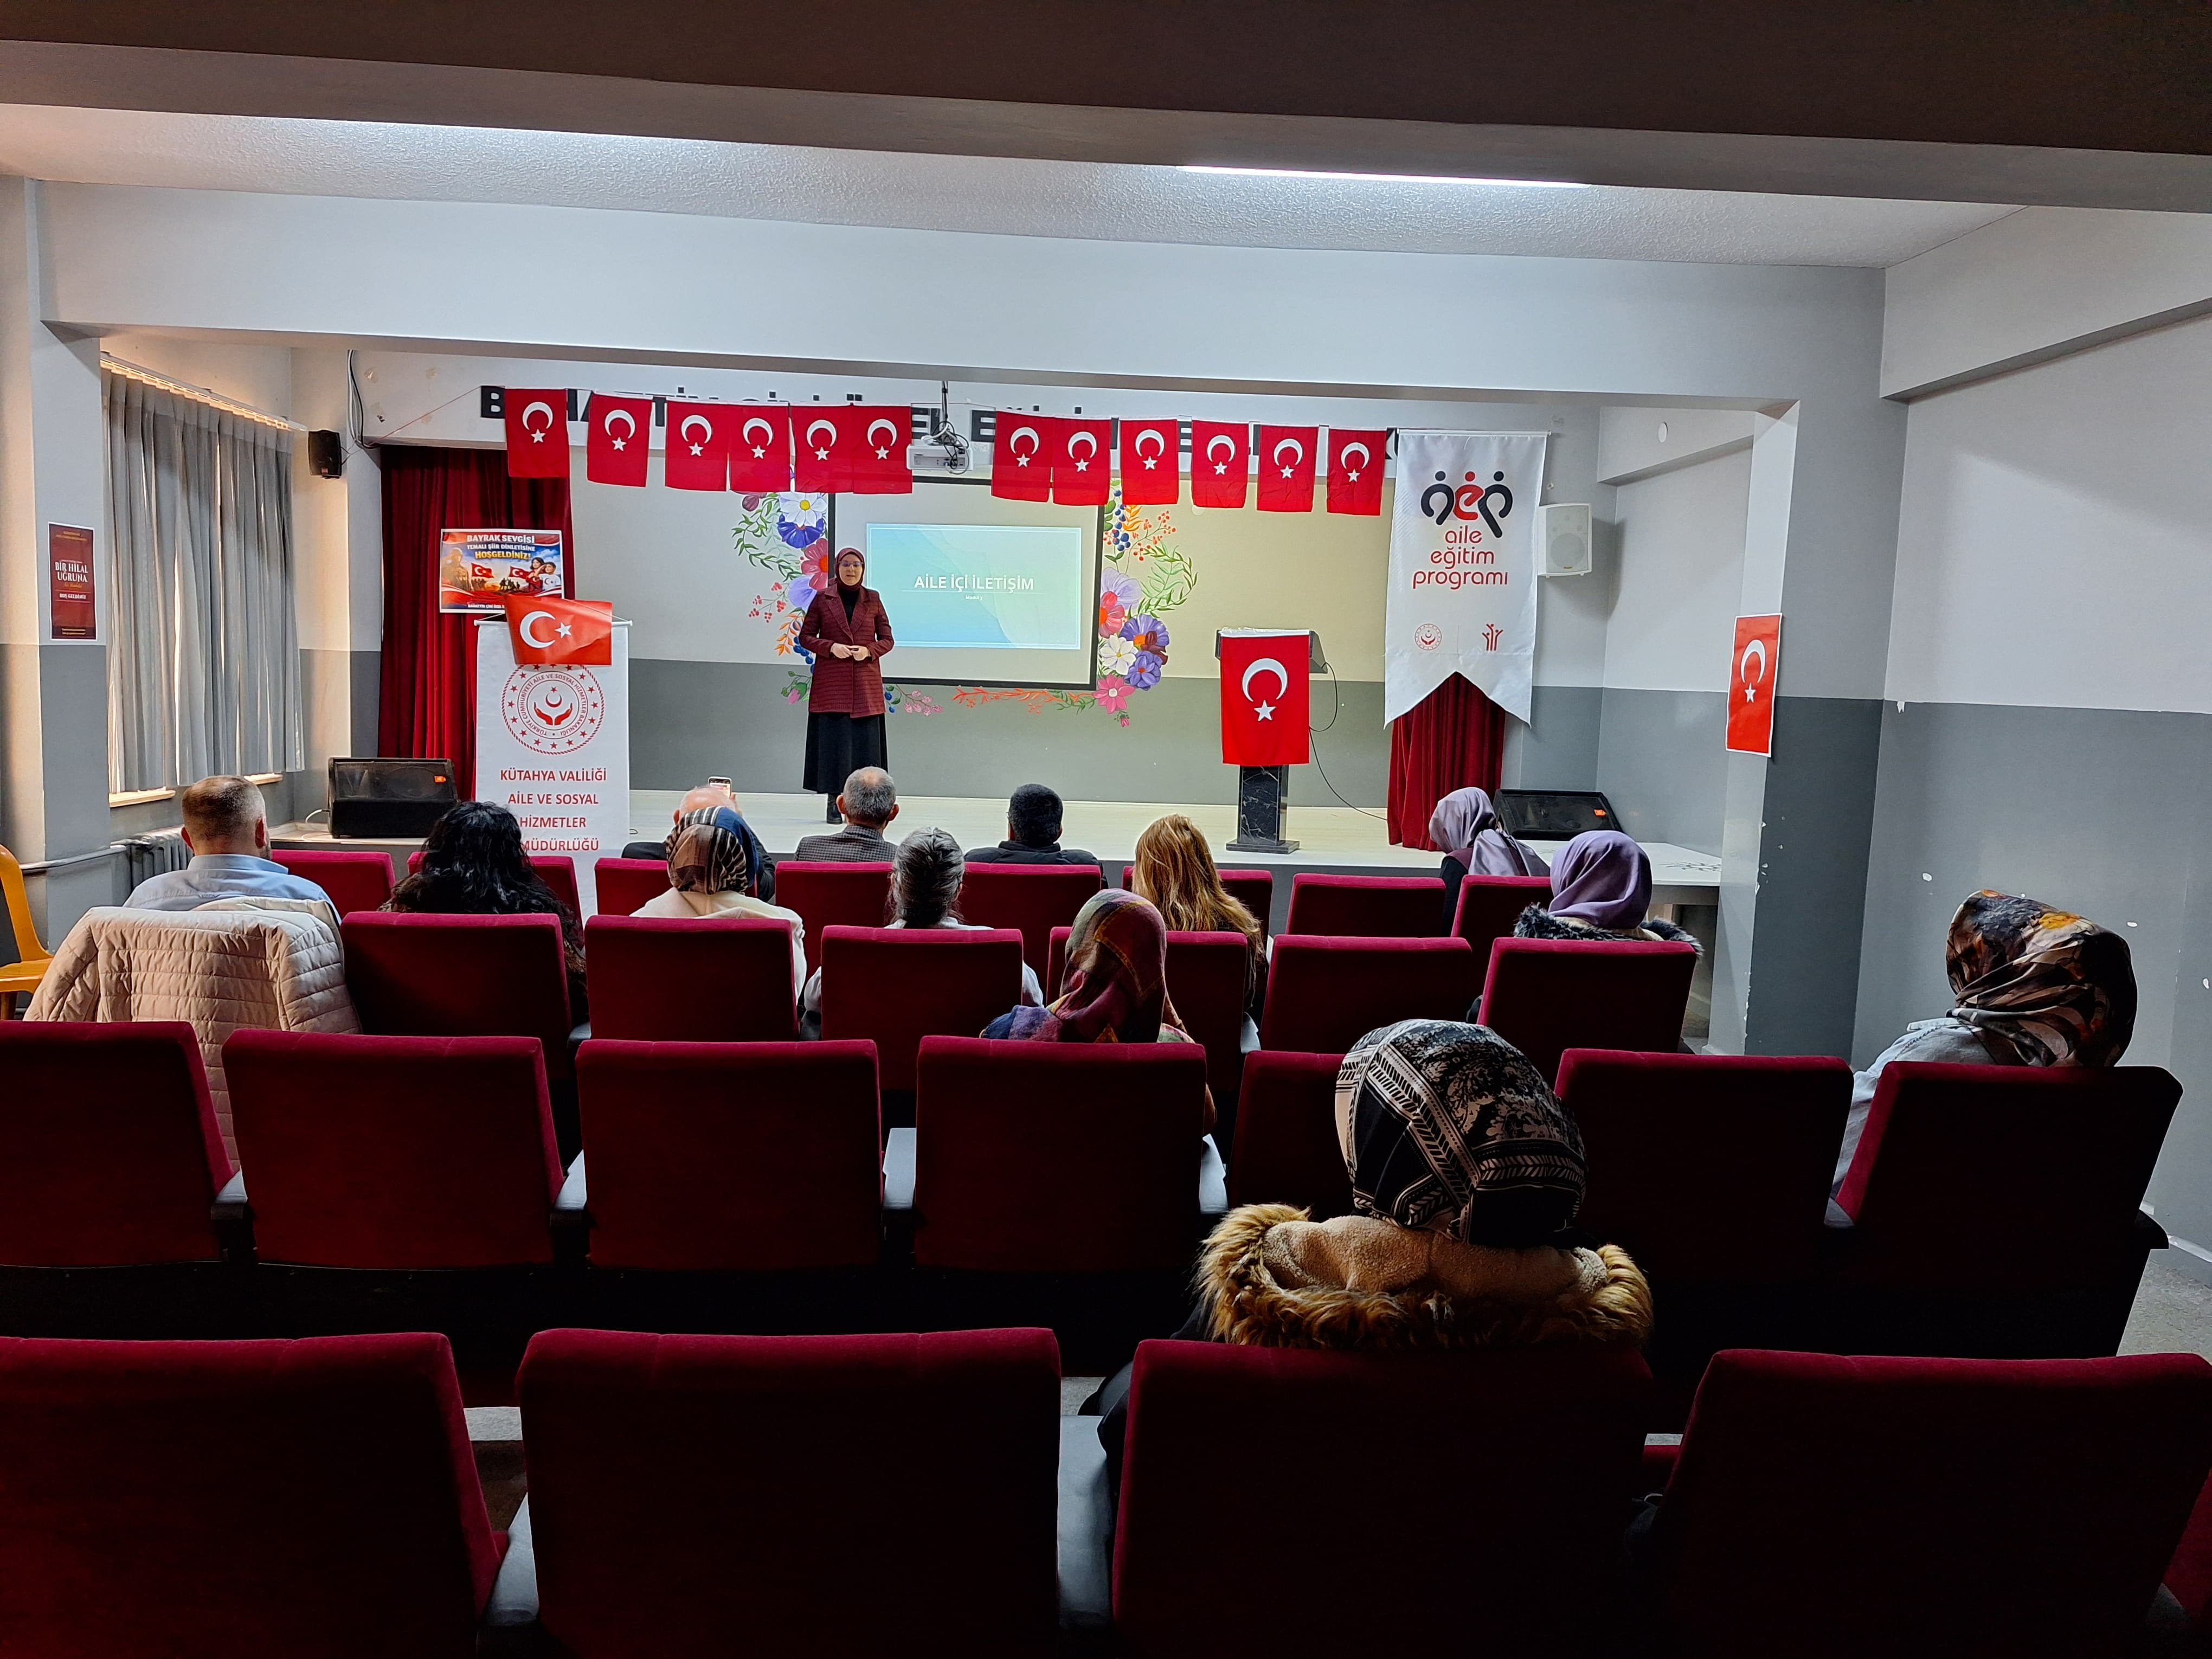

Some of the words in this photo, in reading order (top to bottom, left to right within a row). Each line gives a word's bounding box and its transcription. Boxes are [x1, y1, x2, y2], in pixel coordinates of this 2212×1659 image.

[502, 535, 535, 543] SEVGİSİ
[1445, 525, 1482, 543] aile
[1430, 546, 1494, 569] eğitim
[914, 574, 947, 589] AİLE
[951, 574, 968, 592] İÇİ
[972, 575, 1033, 593] İLETİŞİM
[1413, 571, 1508, 590] programı
[555, 673, 574, 685] SOSYAL
[500, 767, 556, 781] KÜTAHYA
[559, 768, 606, 781] VALİLİĞİ
[508, 791, 533, 804] AİLE
[537, 794, 552, 804] VE
[556, 794, 599, 805] SOSYAL
[520, 814, 586, 828] HİZMETLER
